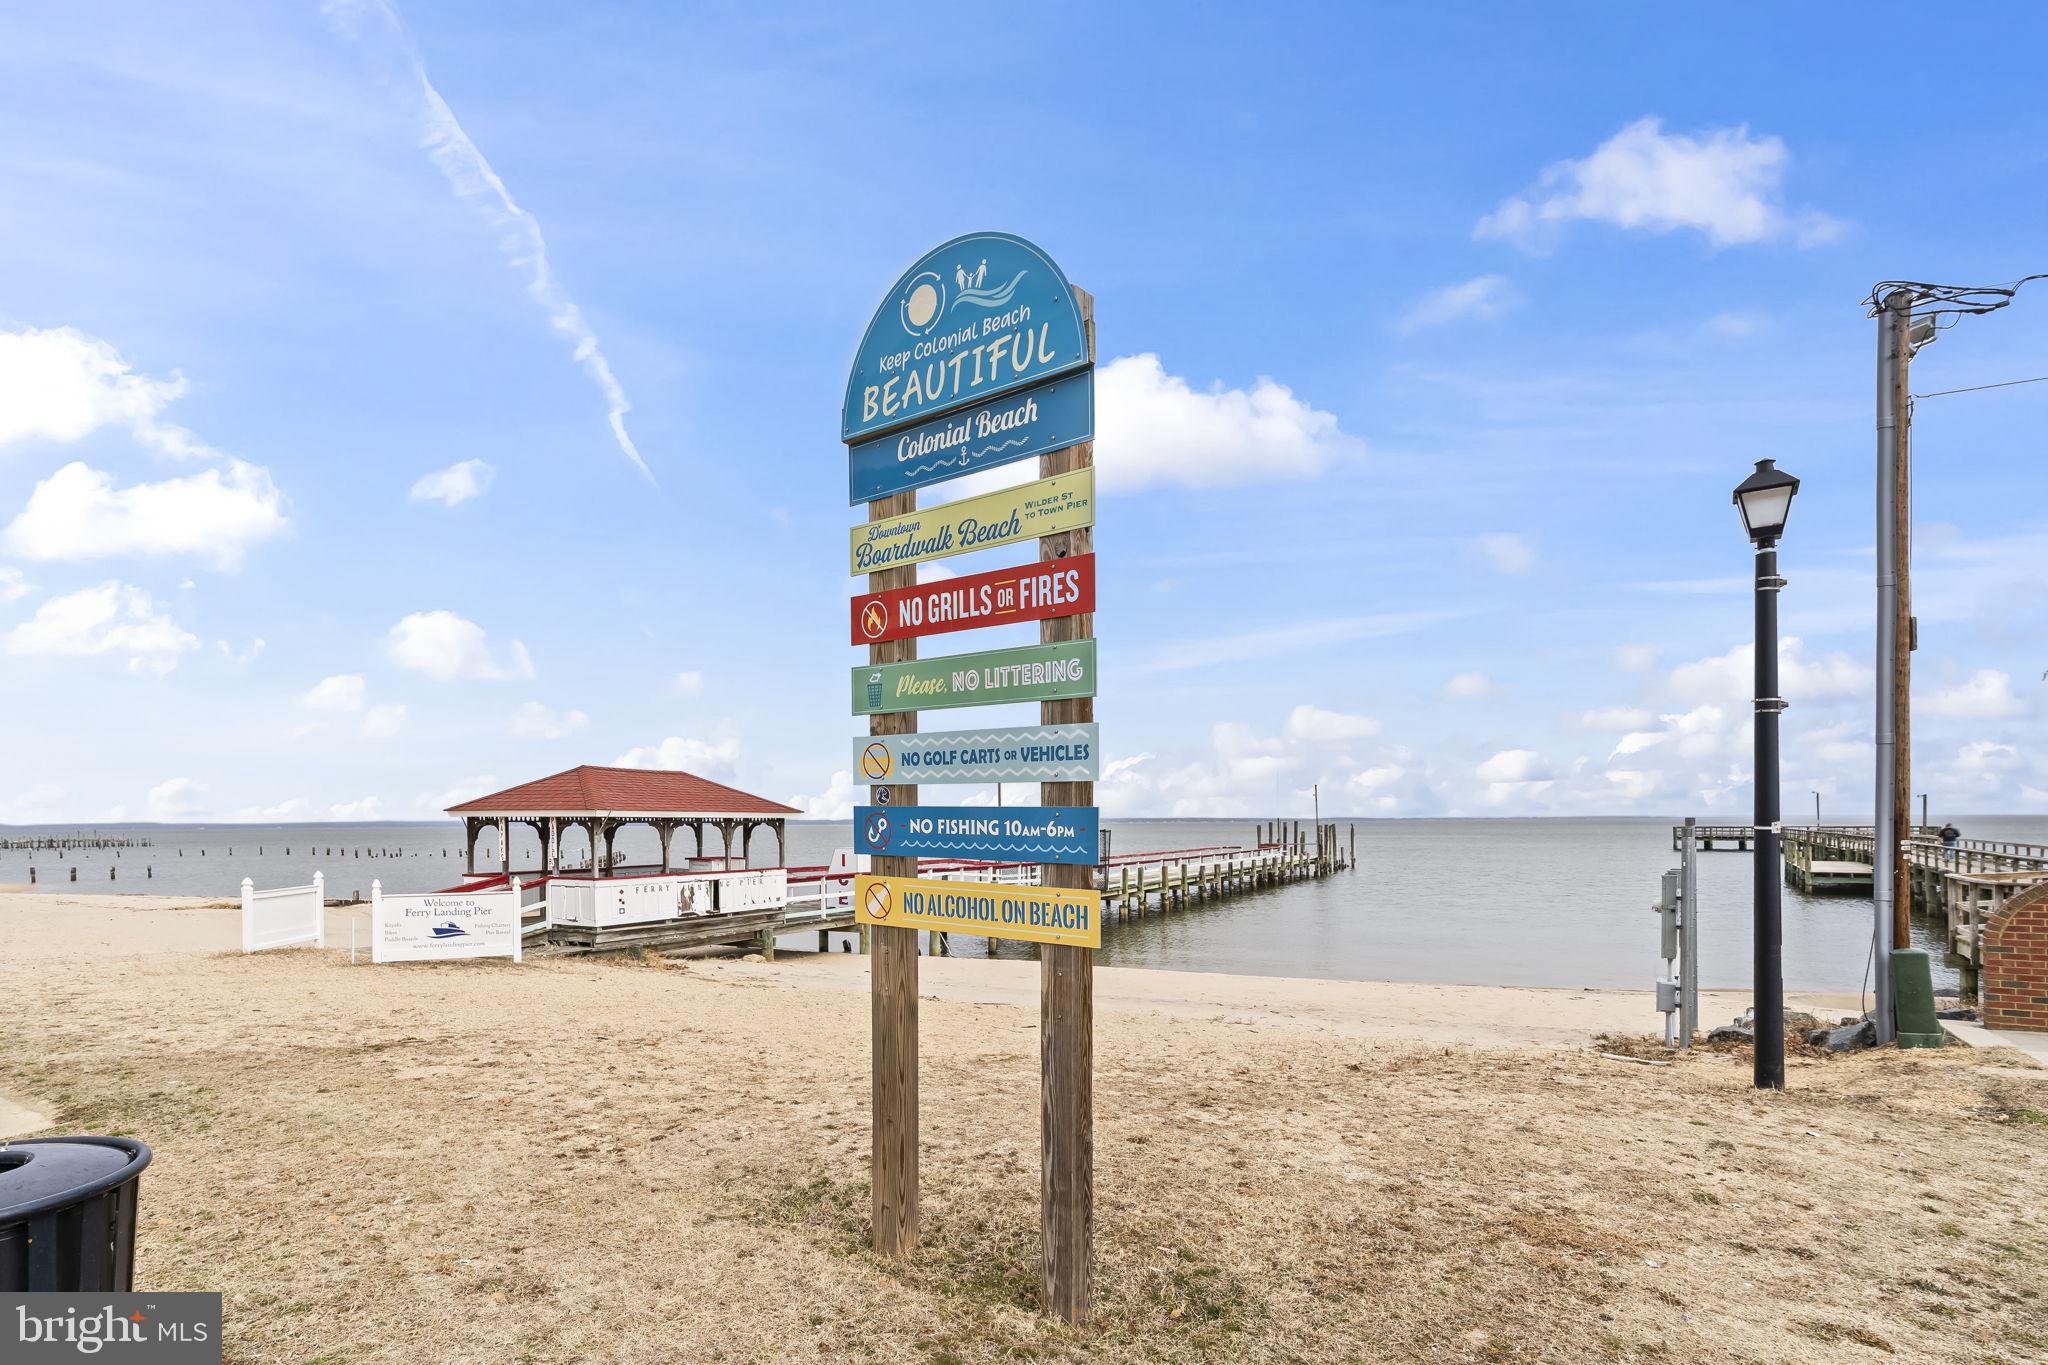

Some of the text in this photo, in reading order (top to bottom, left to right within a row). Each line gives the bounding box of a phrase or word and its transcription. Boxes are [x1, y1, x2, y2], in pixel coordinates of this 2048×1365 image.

[879, 304, 1031, 373] Keep Colonial Beach
[862, 322, 1056, 422] BEAUTIFUL
[897, 398, 1038, 462] Colonial Beach
[1024, 495, 1059, 509] WILDER
[1024, 498, 1088, 520] TO TOWN PIER
[855, 507, 1022, 569] Boardwalk Beach
[867, 520, 921, 542] Downtown
[899, 569, 1080, 628] NO GRILLS OR FIRES
[896, 657, 1083, 698] Please, NO LITTERING
[901, 744, 1090, 767] NO GOLF CARTS OR VEHICLES
[909, 818, 933, 835] NO
[937, 819, 999, 836] FISHING
[635, 884, 670, 894] FERRY
[405, 907, 493, 918] Ferry Landing Pier
[424, 899, 475, 907] Welcome to
[903, 892, 1089, 930] NO ALCOHOL ON BEACH
